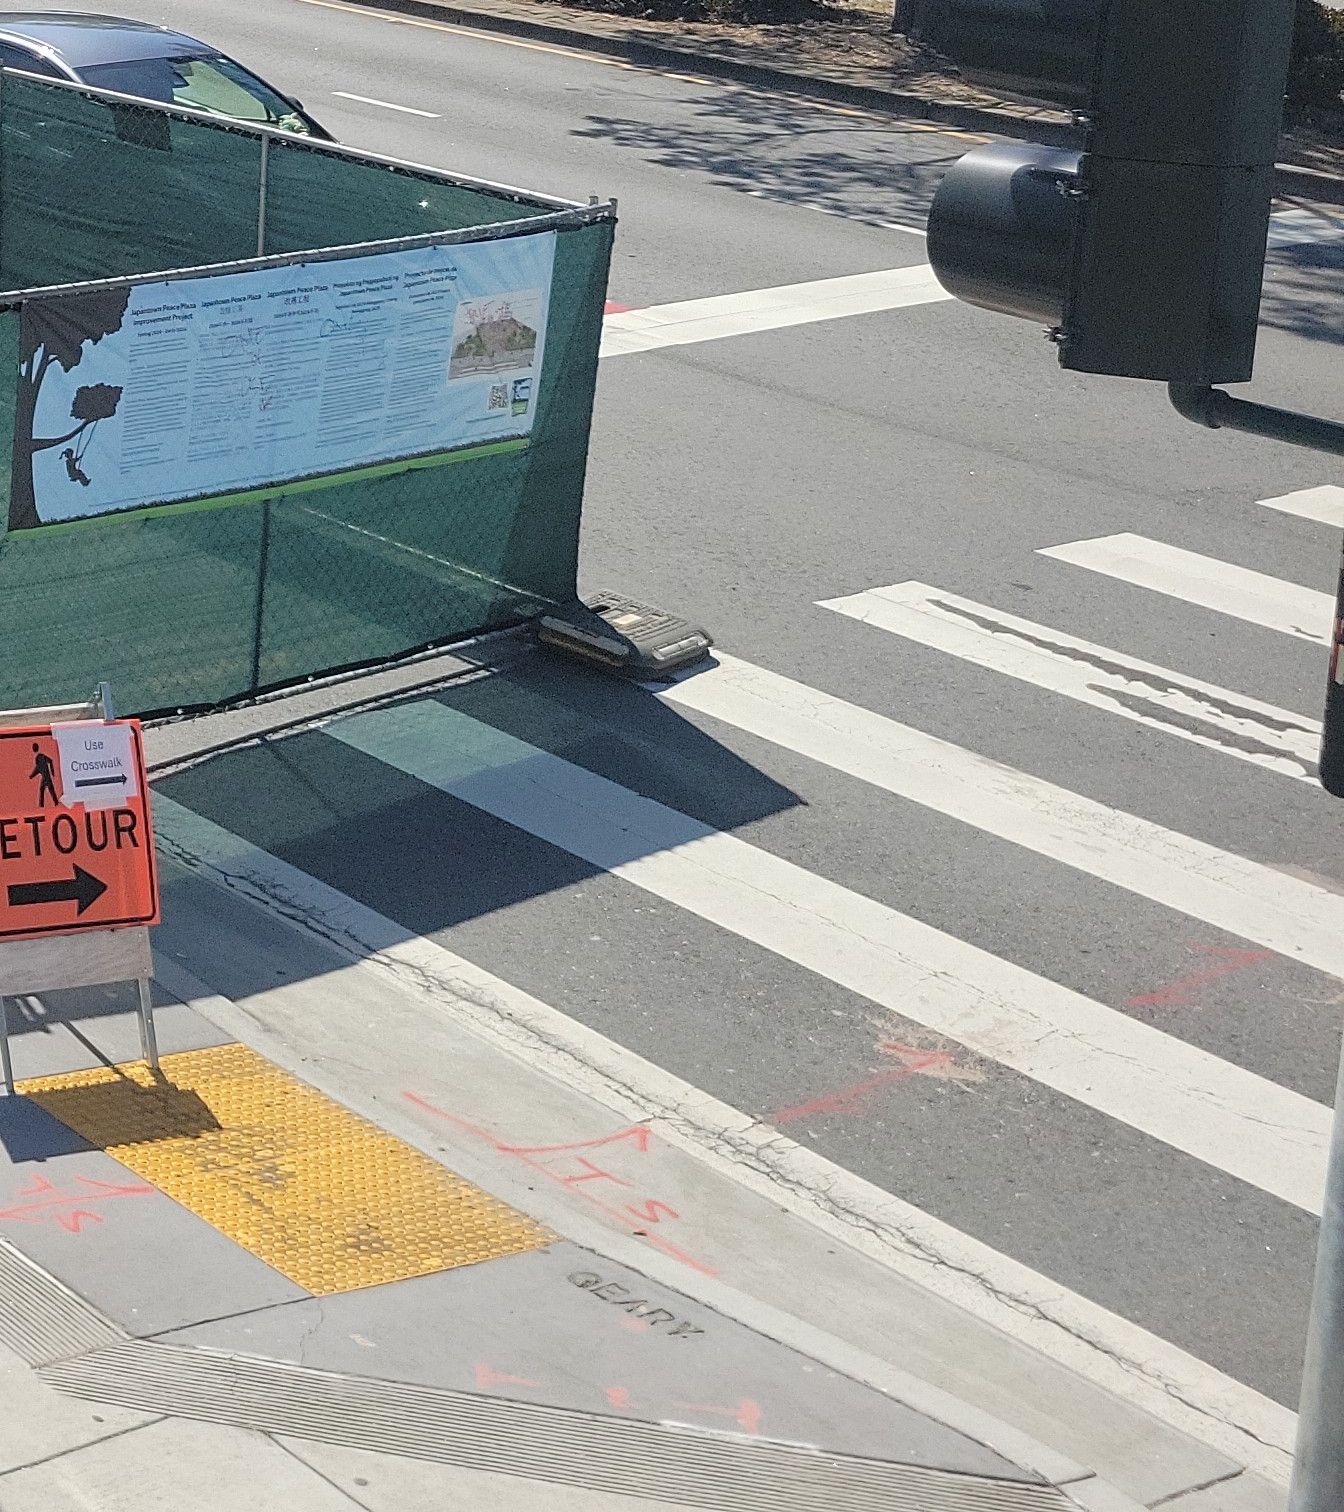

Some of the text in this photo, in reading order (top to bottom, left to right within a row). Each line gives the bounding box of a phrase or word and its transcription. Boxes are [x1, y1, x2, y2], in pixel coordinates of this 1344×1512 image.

[84, 740, 104, 751] Use
[70, 757, 123, 772] Crosswalk
[567, 1271, 705, 1339] GEARY
